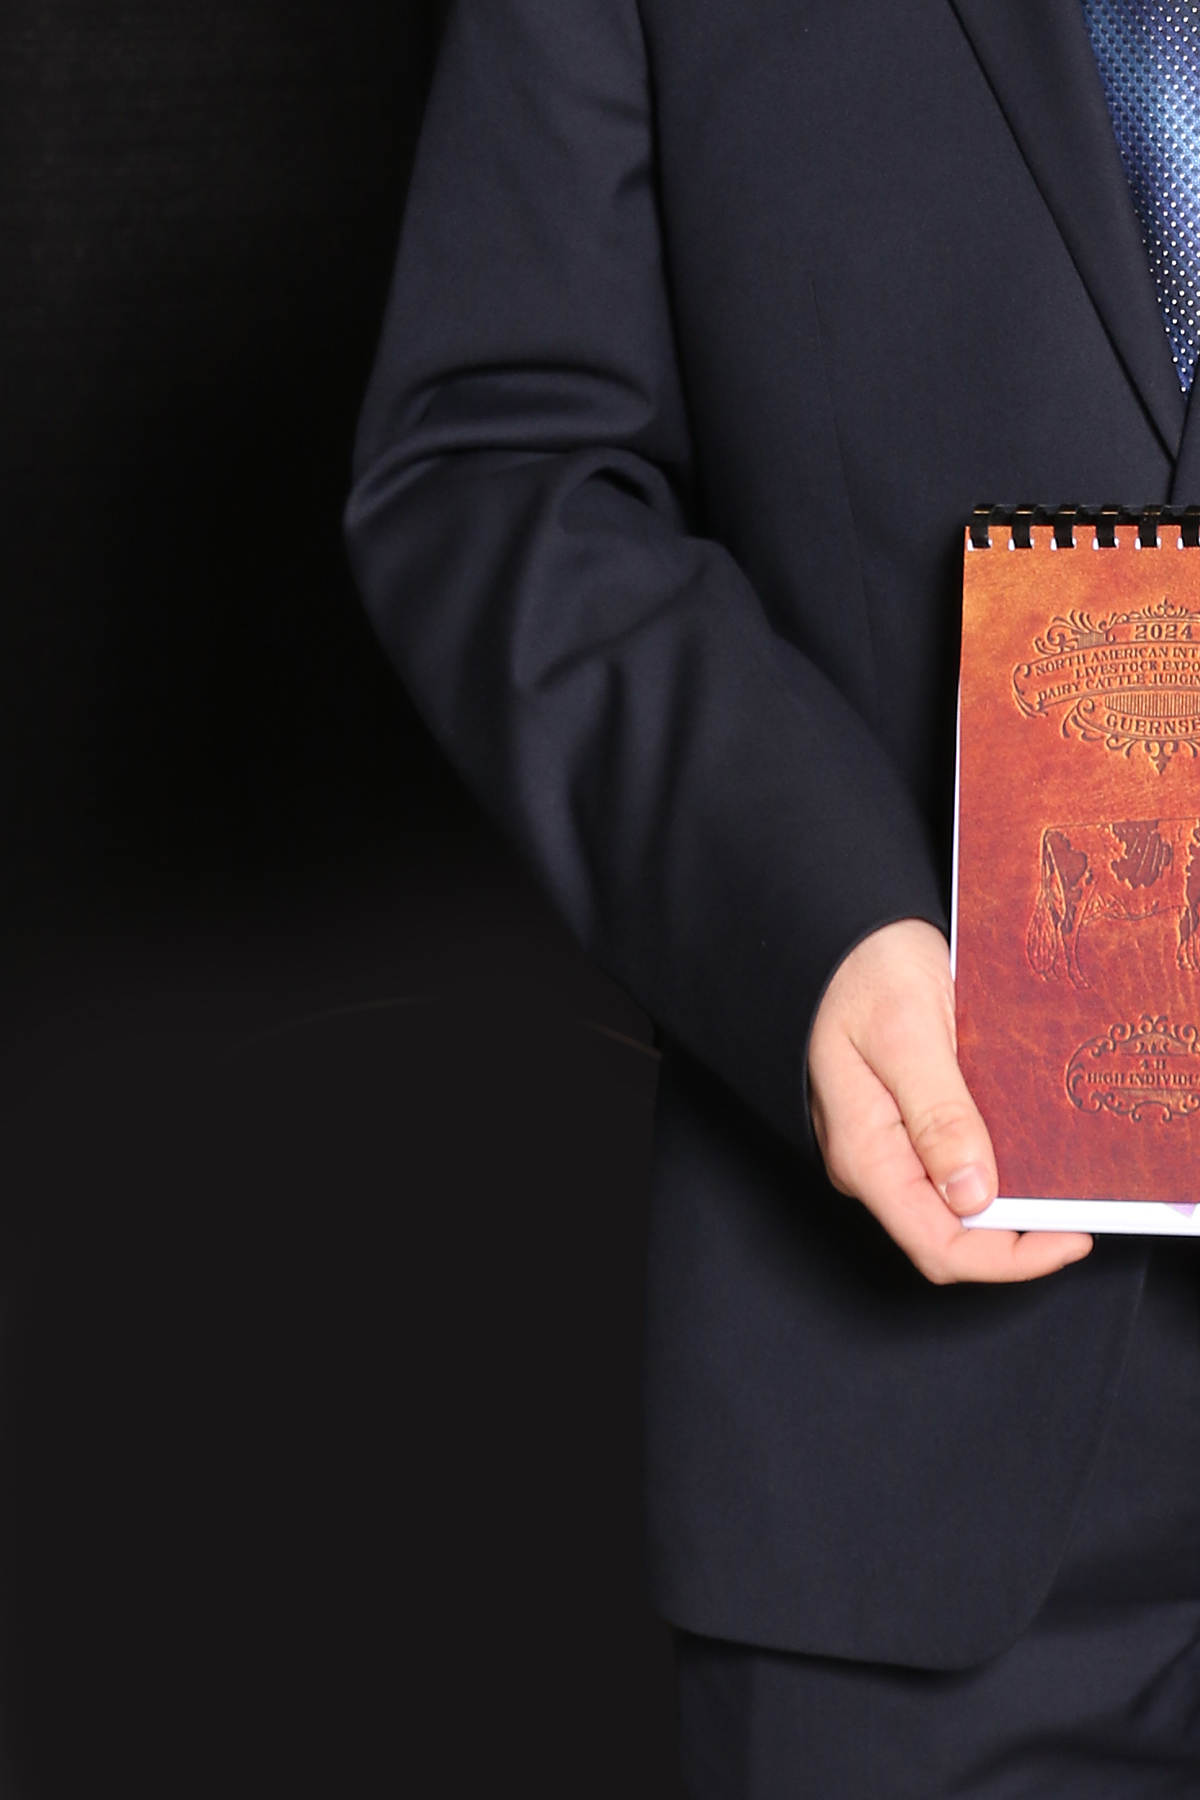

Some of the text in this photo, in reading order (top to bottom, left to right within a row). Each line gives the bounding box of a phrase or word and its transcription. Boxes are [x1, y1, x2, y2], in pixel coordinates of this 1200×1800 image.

[1134, 623, 1194, 640] 2024
[1034, 653, 1087, 677] NORTH
[1090, 646, 1169, 664] AMERICAN
[1074, 660, 1158, 680] LIVESTOCK
[1037, 680, 1081, 702] DAIRY
[1085, 673, 1147, 691] CATTLE
[1086, 1073, 1125, 1085] HIGH
